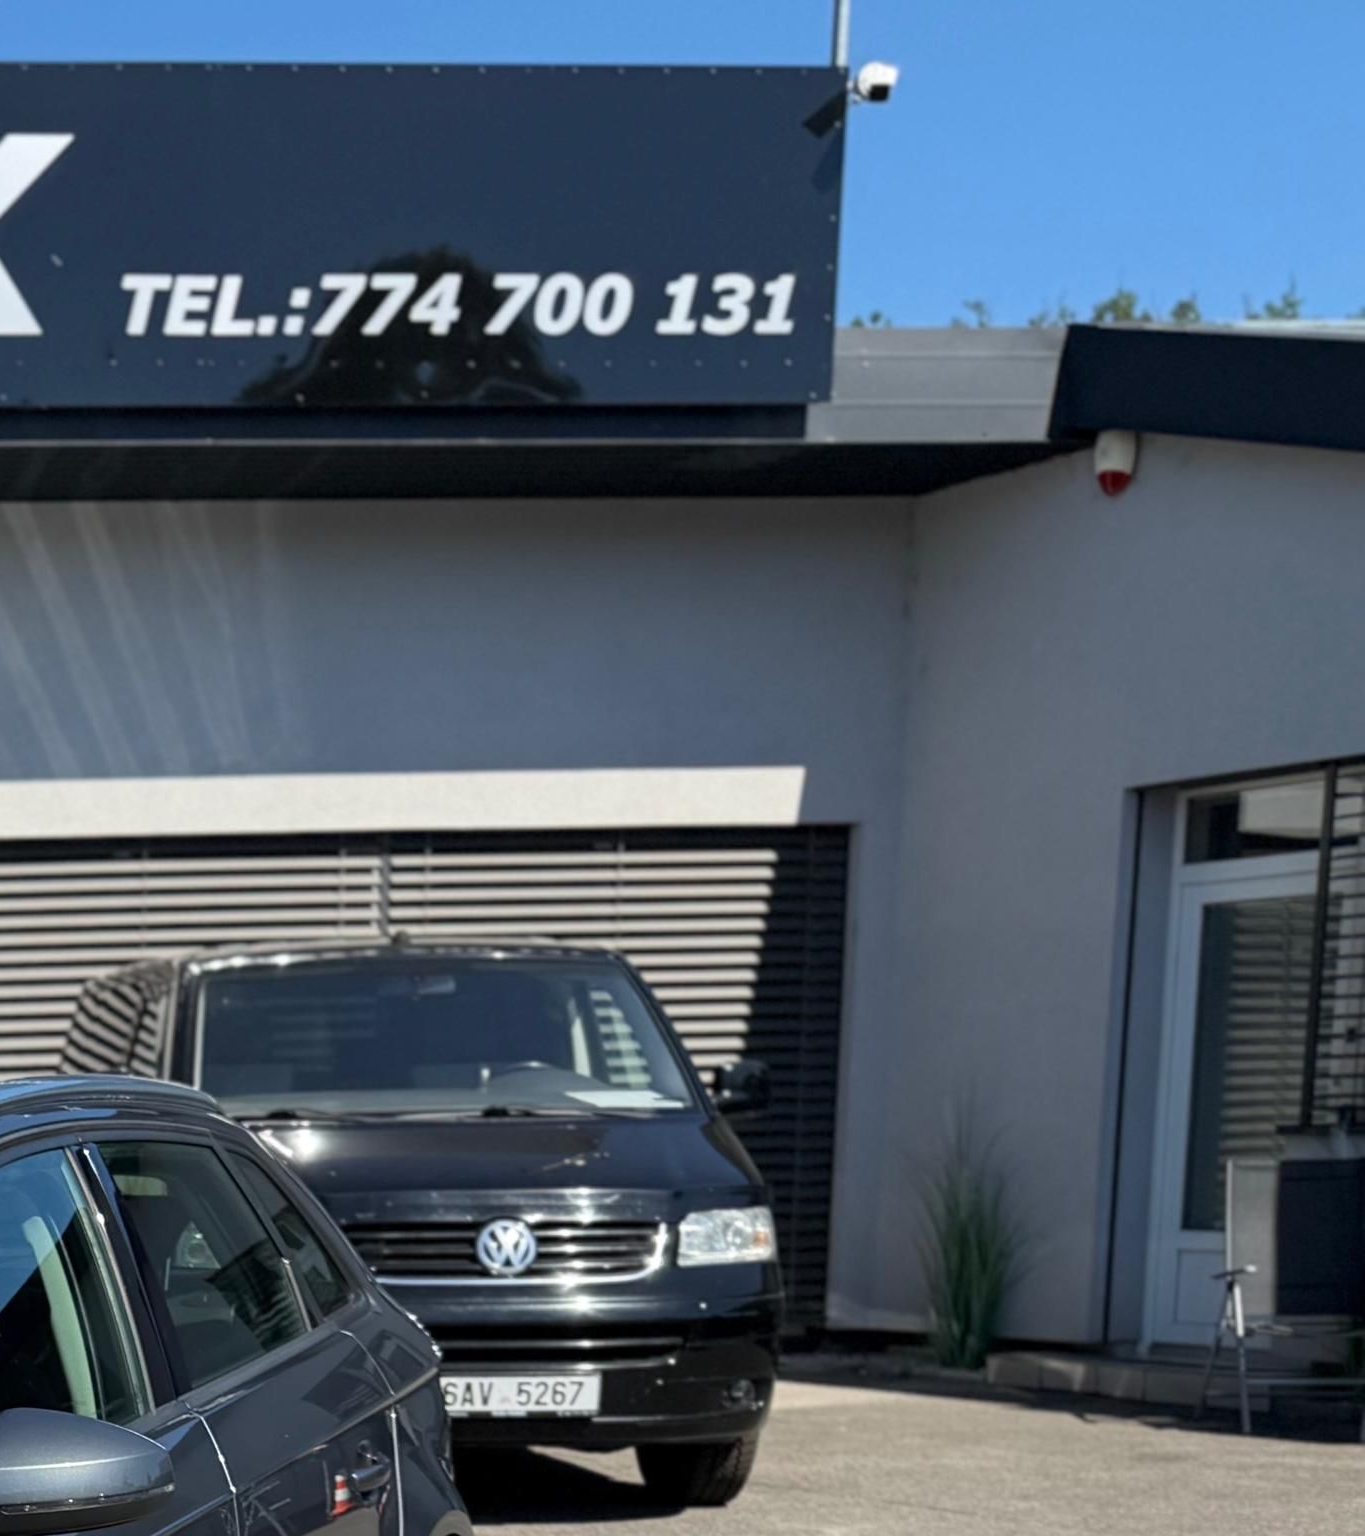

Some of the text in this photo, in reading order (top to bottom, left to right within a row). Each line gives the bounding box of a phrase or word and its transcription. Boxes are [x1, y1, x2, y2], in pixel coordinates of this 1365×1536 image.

[120, 273, 797, 336] TEL.:774 700 131
[515, 1380, 585, 1407] 5267
